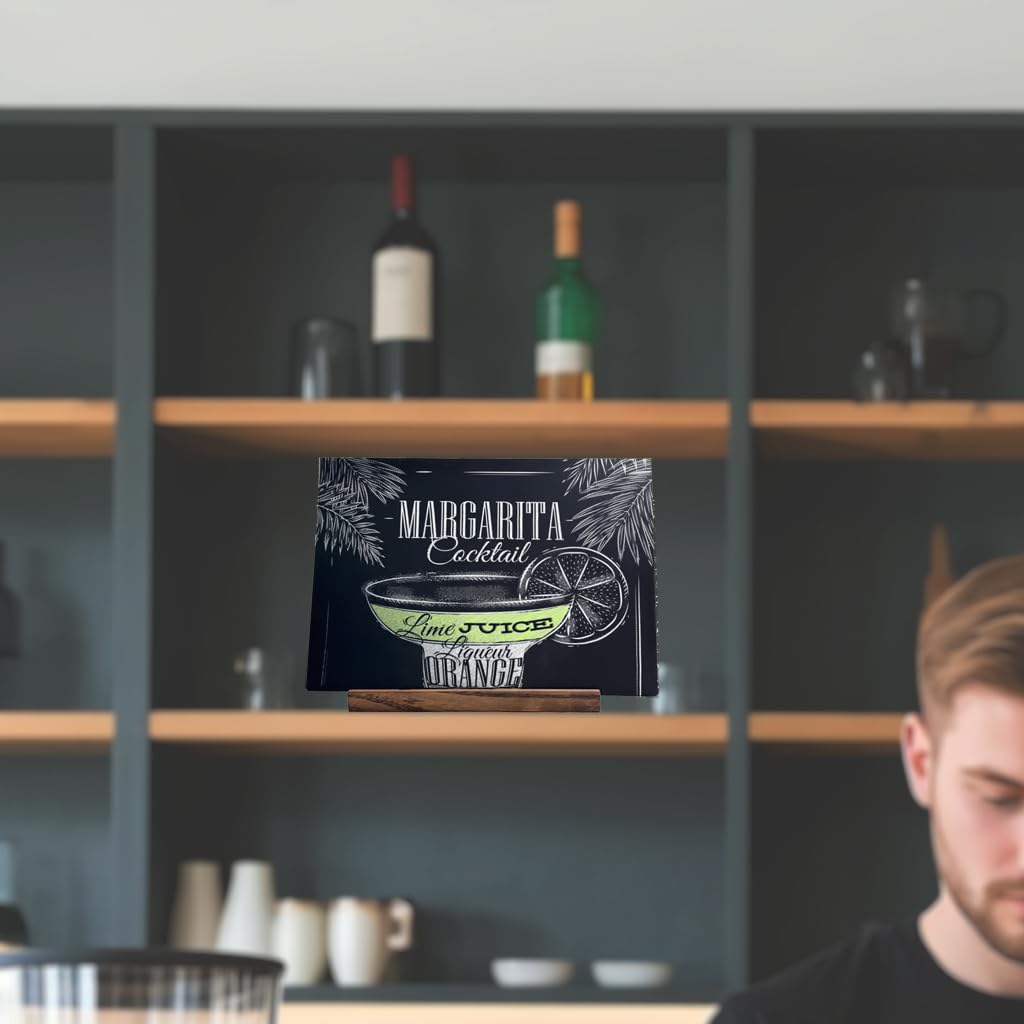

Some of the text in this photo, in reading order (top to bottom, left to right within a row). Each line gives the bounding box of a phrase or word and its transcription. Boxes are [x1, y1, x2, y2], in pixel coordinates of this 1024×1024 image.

[398, 500, 564, 541] MARGARITA
[426, 535, 533, 566] Cocktail
[397, 613, 555, 642] Lime JUICE
[434, 635, 513, 666] Liqueur
[424, 656, 523, 687] ORANGE
